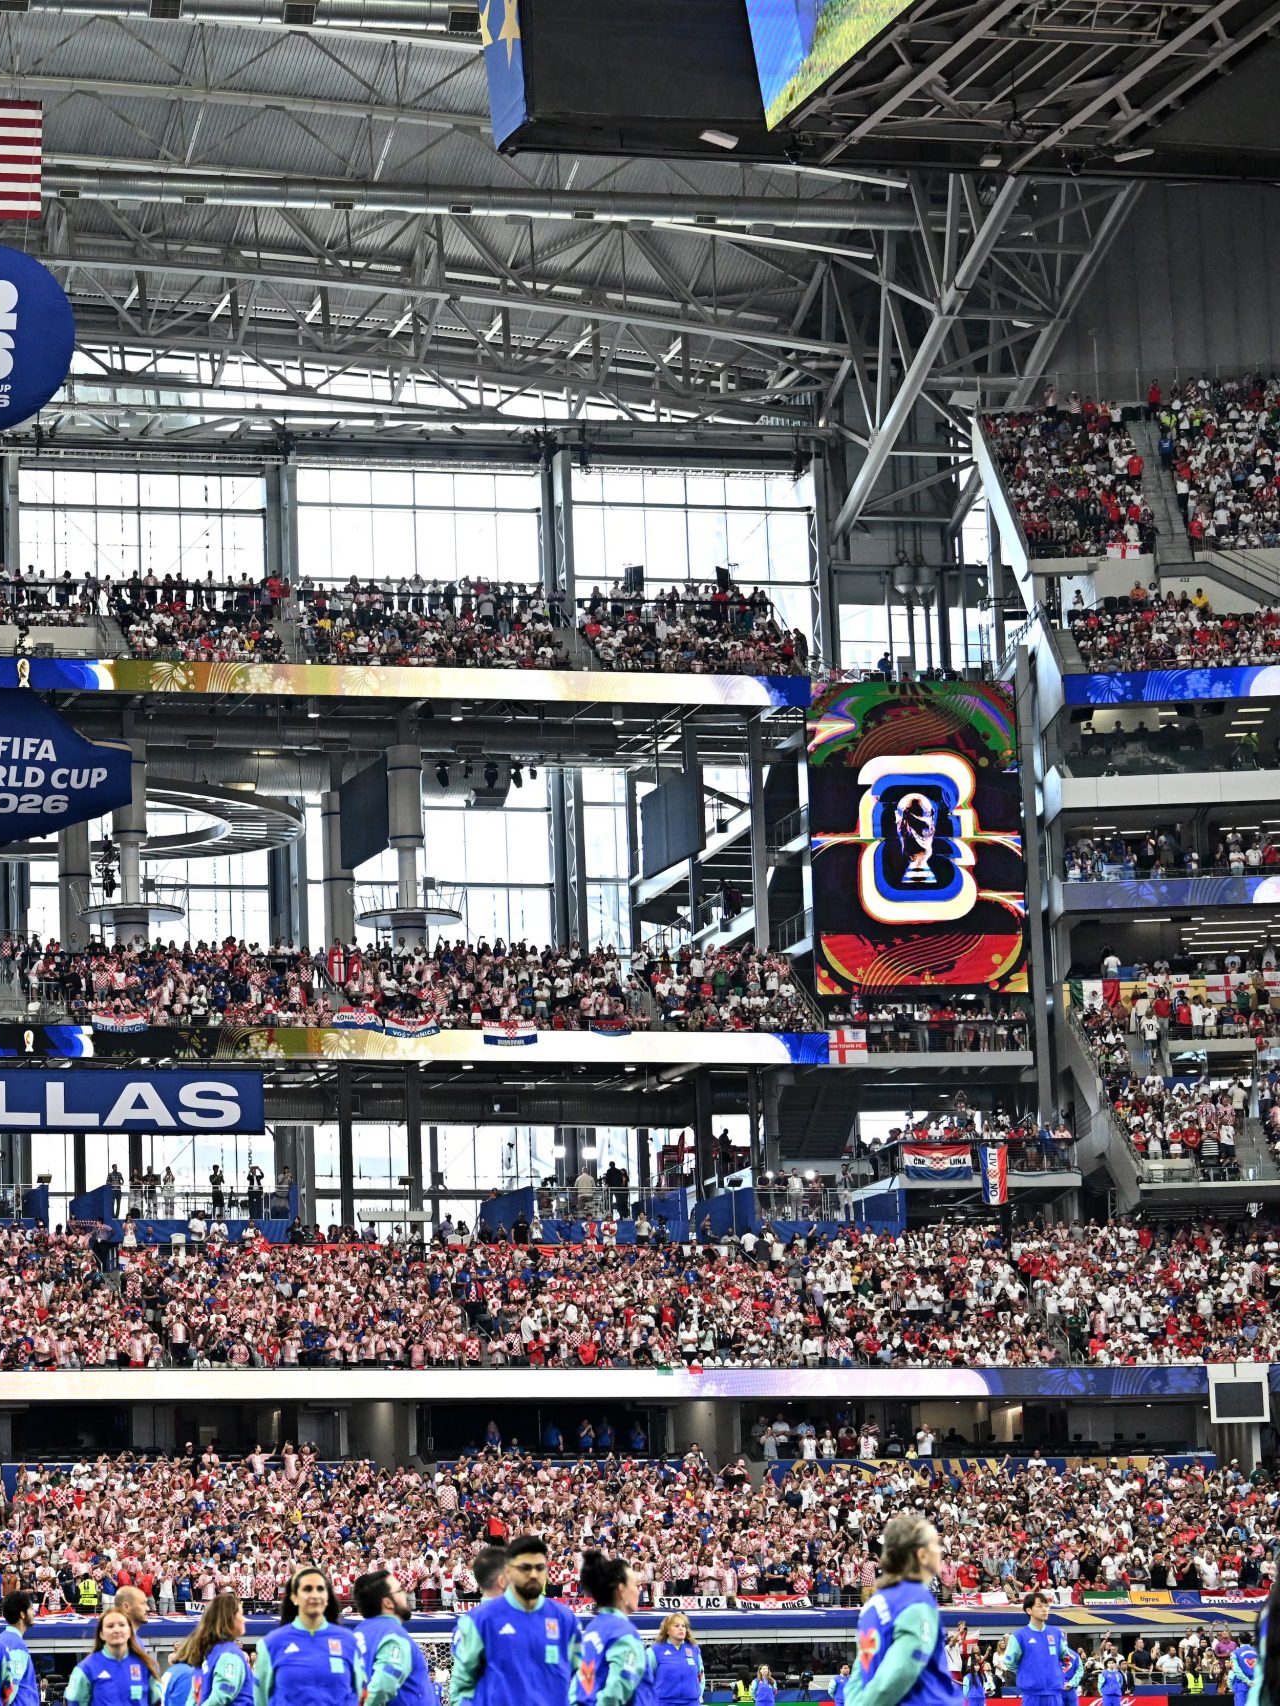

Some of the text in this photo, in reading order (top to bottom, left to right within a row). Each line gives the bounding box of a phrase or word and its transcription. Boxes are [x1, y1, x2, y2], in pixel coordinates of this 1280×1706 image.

[50, 767, 108, 789] CUP
[988, 1152, 997, 1166] LIV
[989, 1183, 998, 1197] NO
[658, 1597, 681, 1608] STO
